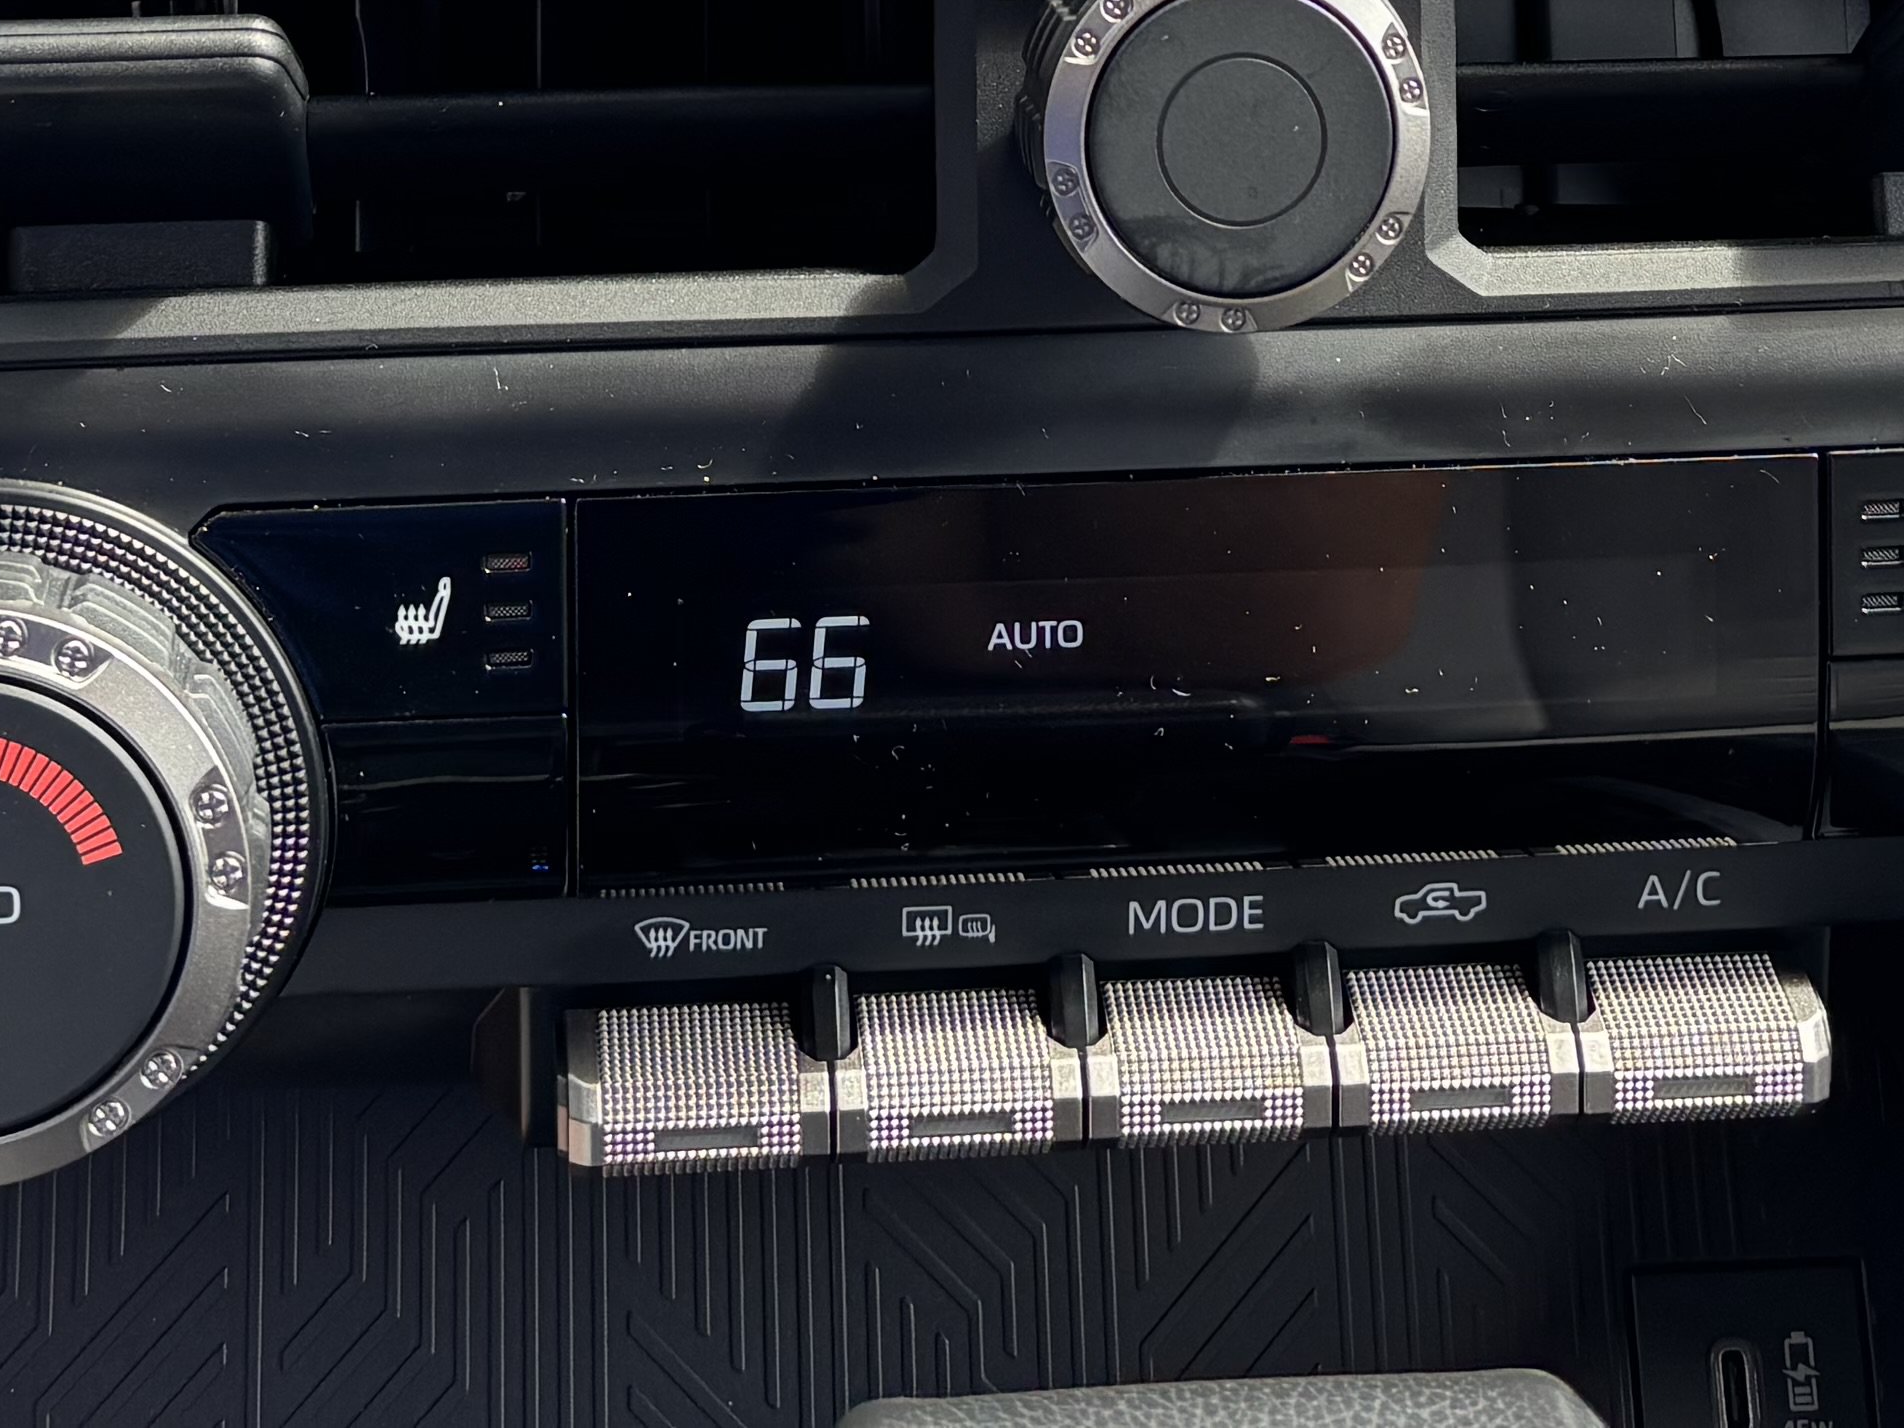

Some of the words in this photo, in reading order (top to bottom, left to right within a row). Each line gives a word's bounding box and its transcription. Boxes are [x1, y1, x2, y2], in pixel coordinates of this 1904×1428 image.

[740, 615, 870, 713] 66
[987, 620, 1084, 652] AUTO
[1638, 870, 1721, 911] A/C
[1128, 895, 1265, 935] MODE
[689, 926, 768, 953] FRONT
